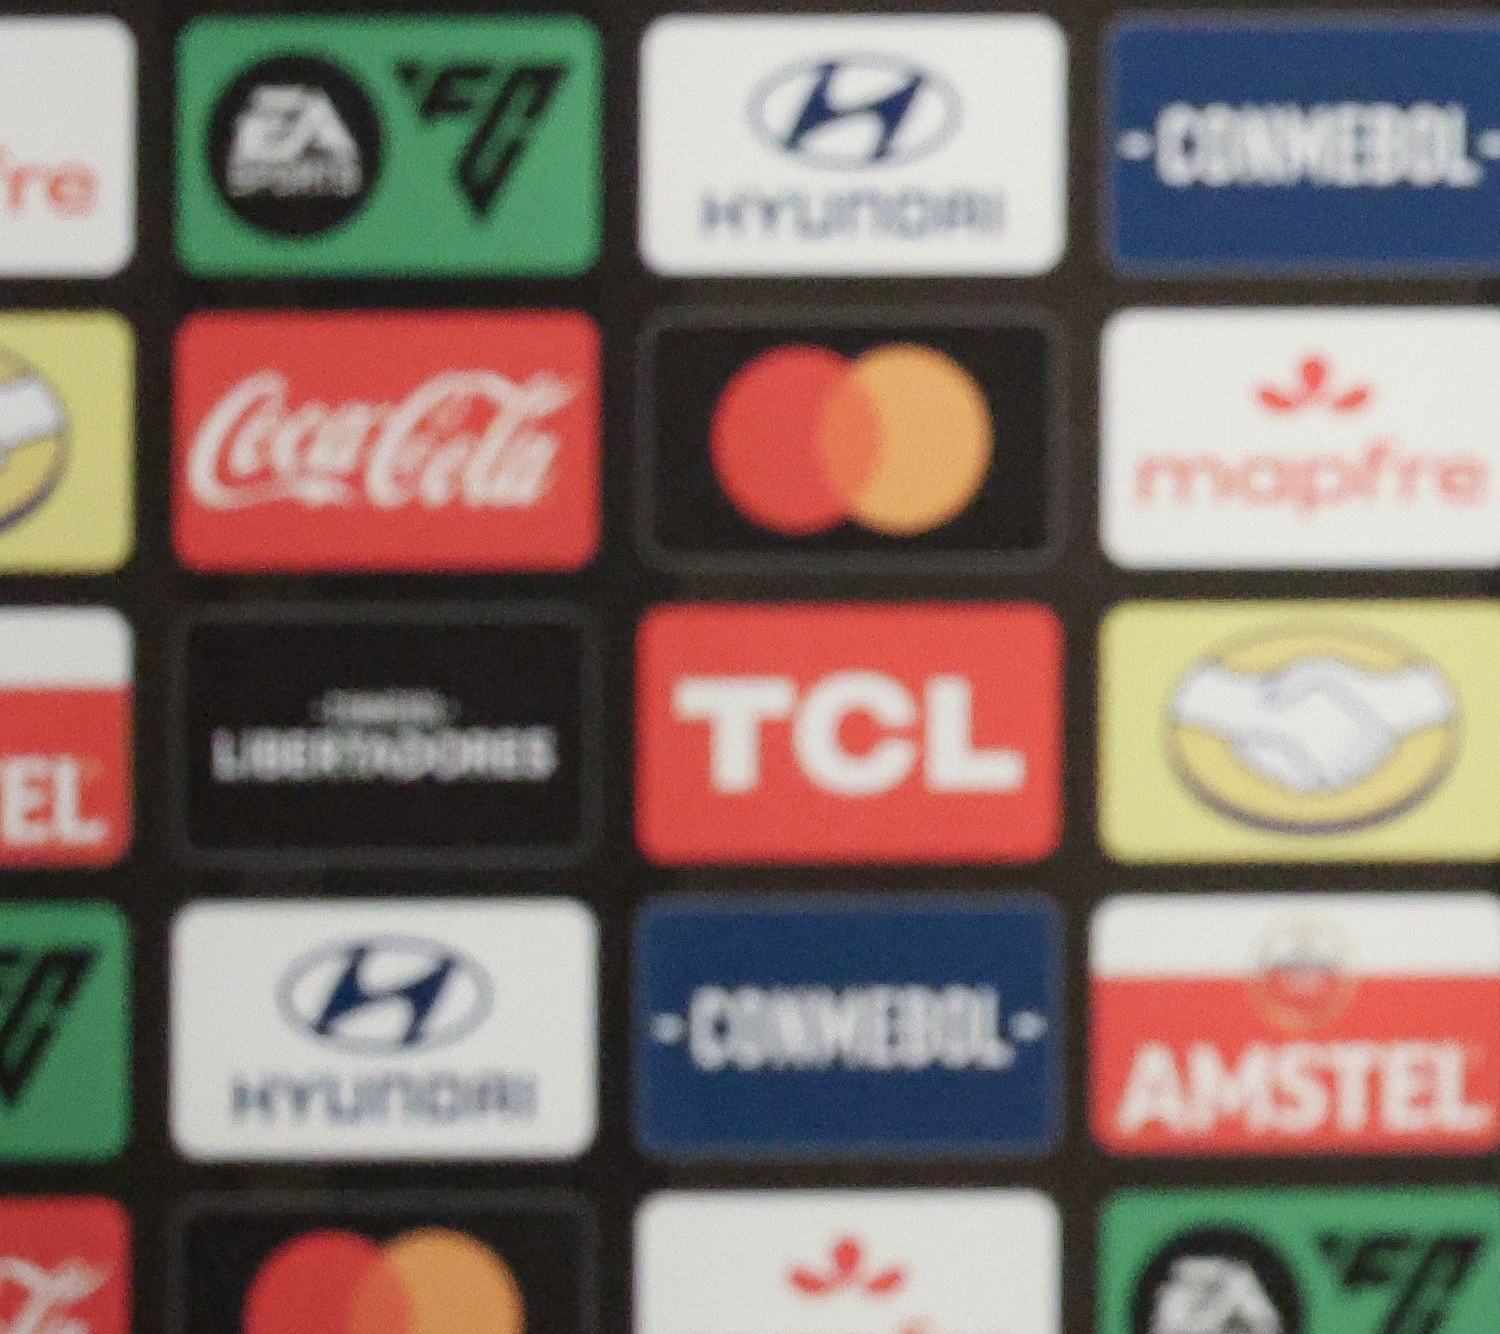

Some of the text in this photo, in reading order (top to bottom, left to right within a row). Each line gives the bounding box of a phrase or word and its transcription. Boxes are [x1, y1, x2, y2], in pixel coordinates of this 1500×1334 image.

[698, 189, 1005, 241] HYUNDAI
[187, 370, 574, 510] Coca-Cola
[1133, 437, 1489, 516] mapfre
[673, 670, 1027, 797] TCL
[229, 1073, 535, 1125] HYUNDAI
[1116, 1039, 1492, 1134] AMSTEL
